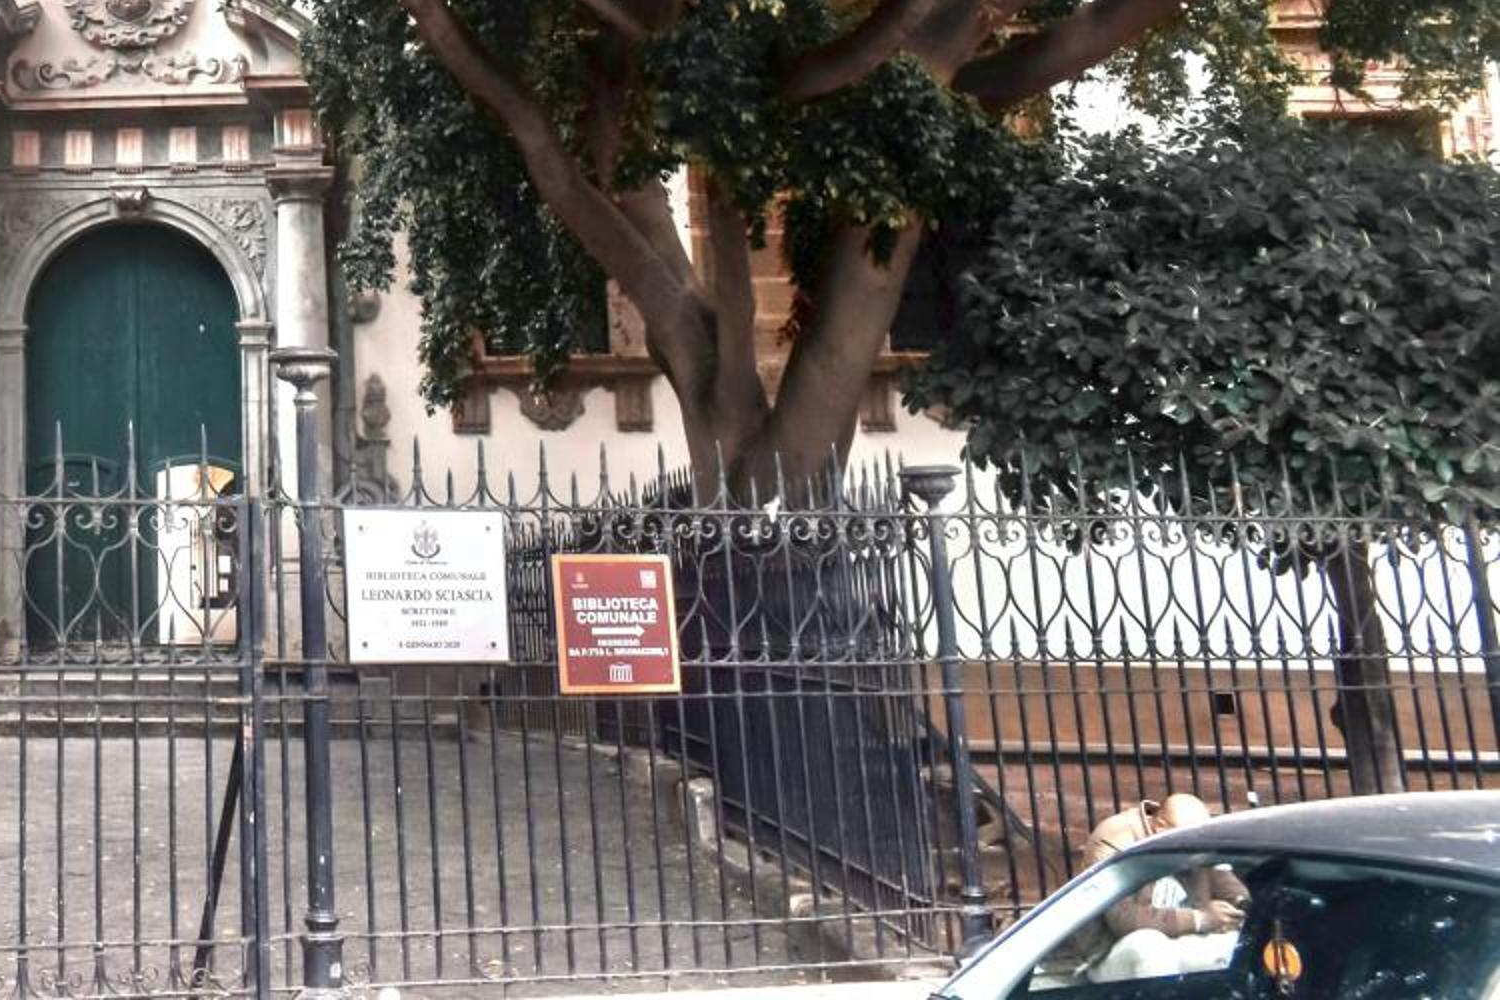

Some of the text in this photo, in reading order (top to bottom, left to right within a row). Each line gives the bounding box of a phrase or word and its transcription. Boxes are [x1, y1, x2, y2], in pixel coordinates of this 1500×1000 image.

[366, 571, 487, 581] BIBLIOTECA COMUNALE
[361, 589, 493, 601] LEONARDO SCIASCIA
[572, 597, 659, 611] BIBLIOTECA
[576, 611, 657, 624] COMUNALE
